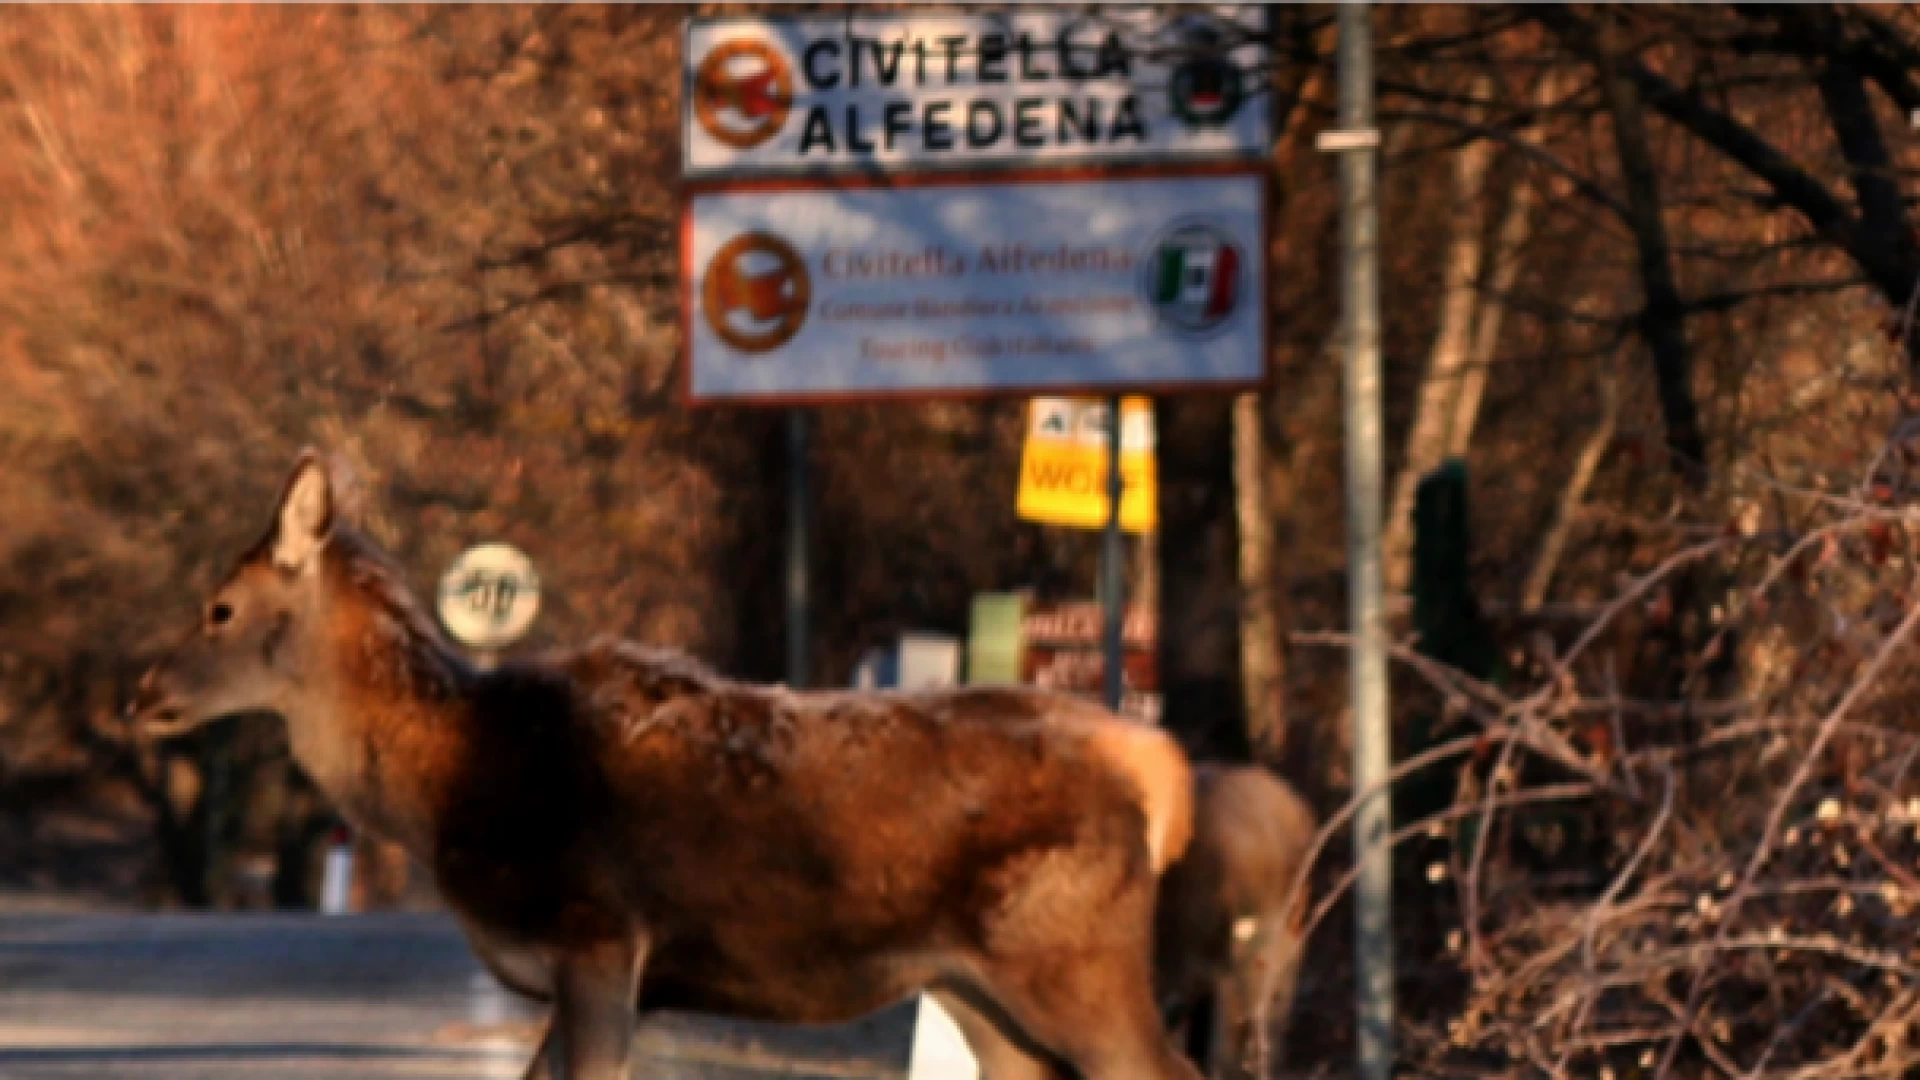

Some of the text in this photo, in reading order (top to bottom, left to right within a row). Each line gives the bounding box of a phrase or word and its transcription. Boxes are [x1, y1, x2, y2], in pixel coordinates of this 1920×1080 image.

[802, 31, 1131, 89] CIVITELLA
[799, 96, 1148, 155] ALFEDENA
[821, 241, 1135, 279] Civitella Alfedena
